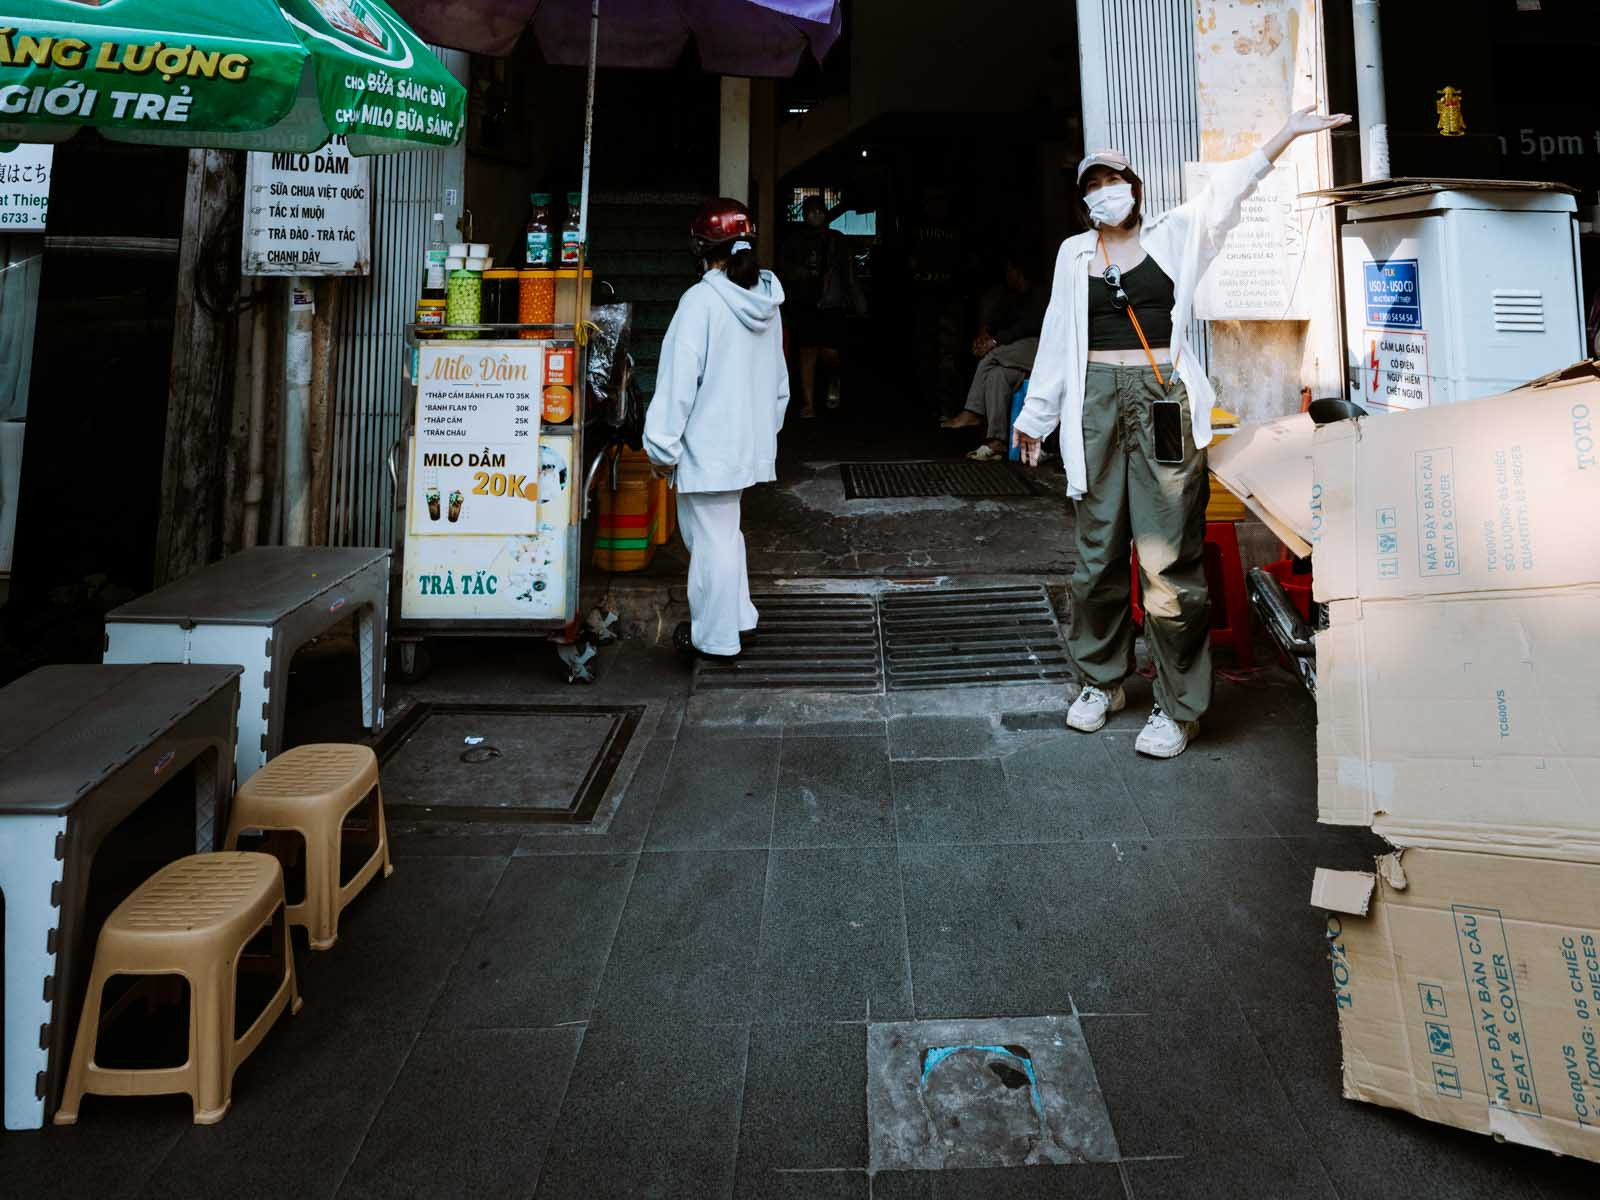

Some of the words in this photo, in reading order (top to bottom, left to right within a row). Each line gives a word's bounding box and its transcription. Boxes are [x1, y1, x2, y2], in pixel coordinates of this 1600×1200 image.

[95, 41, 250, 82] LƯỢNG
[0, 80, 98, 117] GIỚI
[110, 85, 193, 122] TRẺ
[345, 75, 365, 90] CHO
[396, 77, 428, 104] SÁNG
[430, 85, 446, 108] ĐỦ
[361, 104, 393, 128] MILO
[395, 108, 424, 132] BỮA
[426, 114, 453, 138] SÁNG
[1519, 129, 1584, 161] 5pm
[271, 152, 310, 172] MILO
[13, 194, 49, 209] Thiep
[270, 182, 288, 196] SỮA
[290, 185, 315, 198] CHUA
[318, 184, 338, 200] VIỆT
[340, 185, 365, 200] QUỐC
[290, 204, 299, 218] XÍ
[301, 205, 325, 221] MUỘI
[268, 225, 287, 240] TRÀ
[289, 225, 309, 240] ĐÀO
[317, 226, 335, 241] TRÀ
[267, 250, 299, 262] CHANH
[425, 354, 472, 381] Milo
[1387, 373, 1403, 384] NGUY
[1571, 404, 1595, 470] TOTO
[423, 453, 463, 467] MILO
[469, 446, 505, 467] DẦM
[471, 471, 527, 498] 20K
[1440, 474, 1453, 518] COVER
[1443, 533, 1456, 568] SEAT
[1483, 520, 1497, 572] TC600VS
[419, 571, 456, 595] TRÀ
[461, 570, 498, 595] TẮC
[1496, 689, 1510, 739] TC600VS
[1492, 954, 1516, 1024] COVER
[1575, 999, 1590, 1019] 05
[1507, 1031, 1521, 1045] &
[1510, 1050, 1533, 1105] SEAT
[1562, 1045, 1591, 1128] TC600VS
